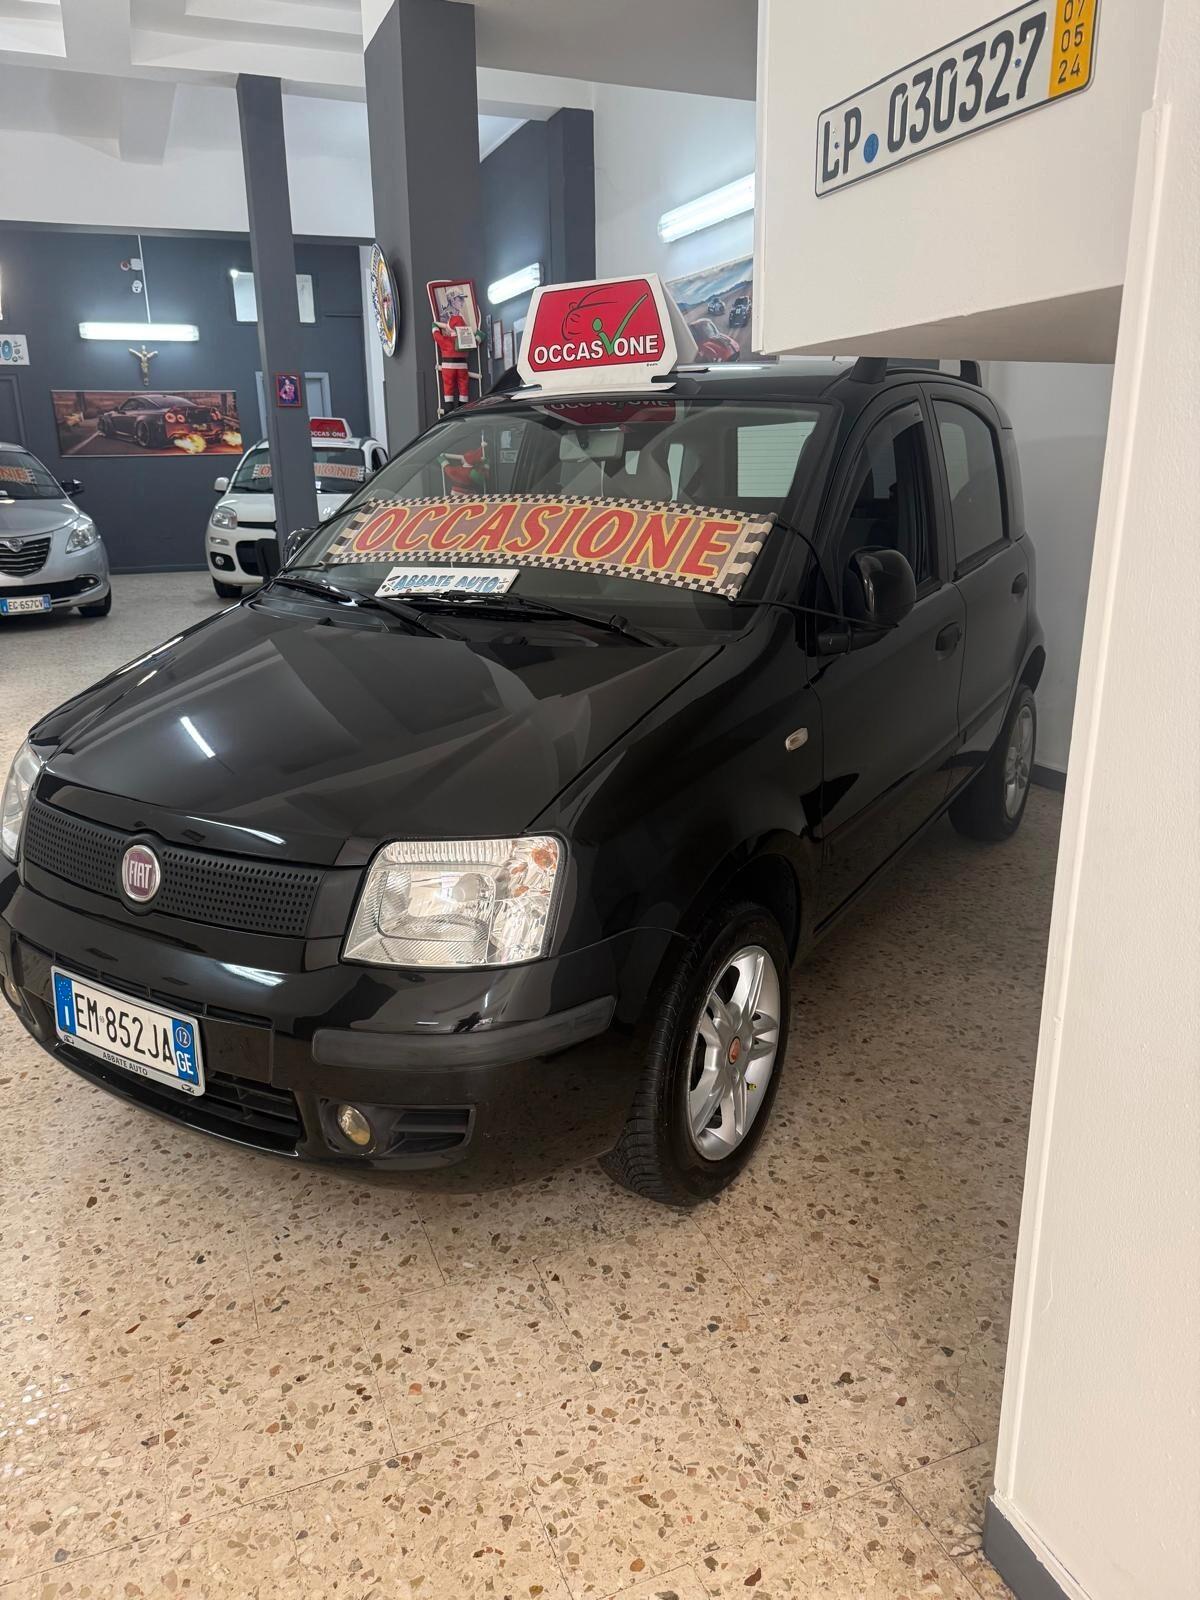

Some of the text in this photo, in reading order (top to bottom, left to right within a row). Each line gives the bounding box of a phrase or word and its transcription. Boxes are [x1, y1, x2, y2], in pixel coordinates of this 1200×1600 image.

[1061, 22, 1085, 53] 05
[886, 11, 1047, 153] 030327
[1057, 53, 1081, 85] 24
[353, 503, 742, 579] OCCASIONE
[393, 574, 500, 593] ABBATE AUTO
[129, 859, 153, 890] FIAT
[74, 992, 175, 1066] EM 852JA
[178, 1029, 189, 1045] 12
[102, 1051, 149, 1077] ABBATE AUTO
[176, 1050, 194, 1075] GE
